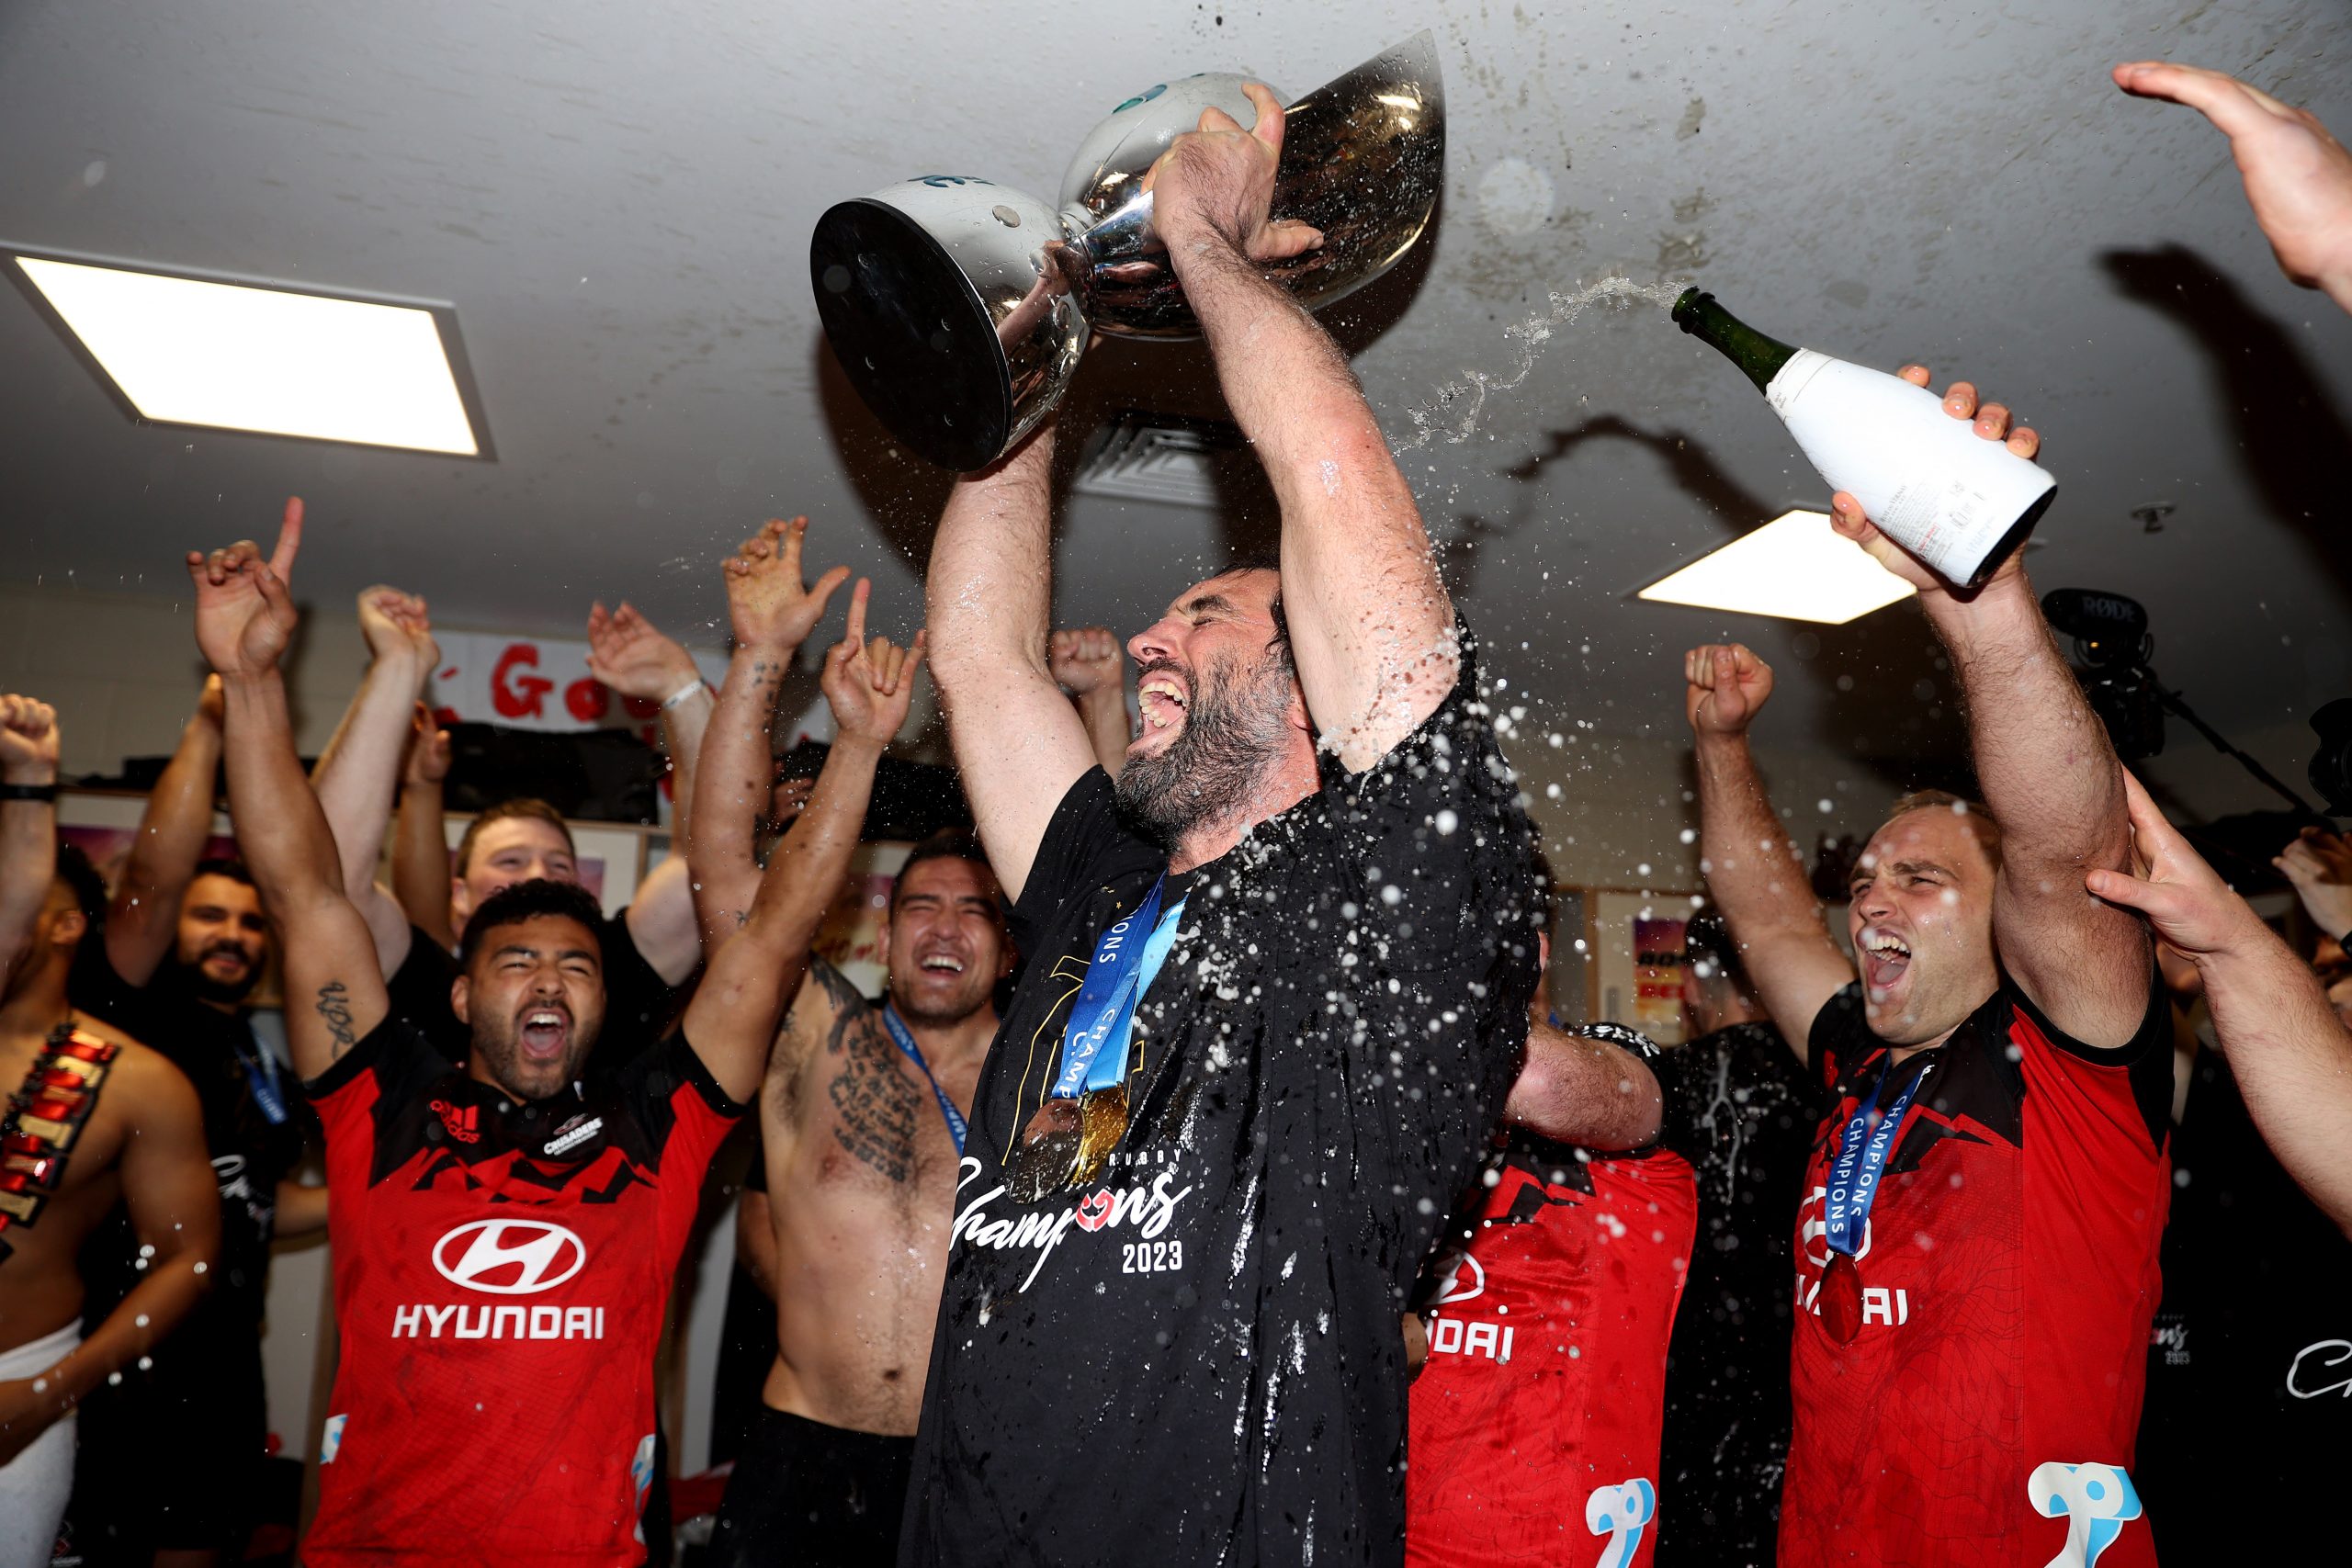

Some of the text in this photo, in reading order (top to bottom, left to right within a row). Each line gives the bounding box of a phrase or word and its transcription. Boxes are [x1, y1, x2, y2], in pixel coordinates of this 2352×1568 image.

[543, 1116, 603, 1156] CRUSADERS
[1850, 1095, 1907, 1217] CHAMPIONS
[1831, 1117, 1864, 1234] CHAMPIONS
[1122, 1240, 1182, 1273] 2023
[391, 1303, 604, 1340] HYUNDAI
